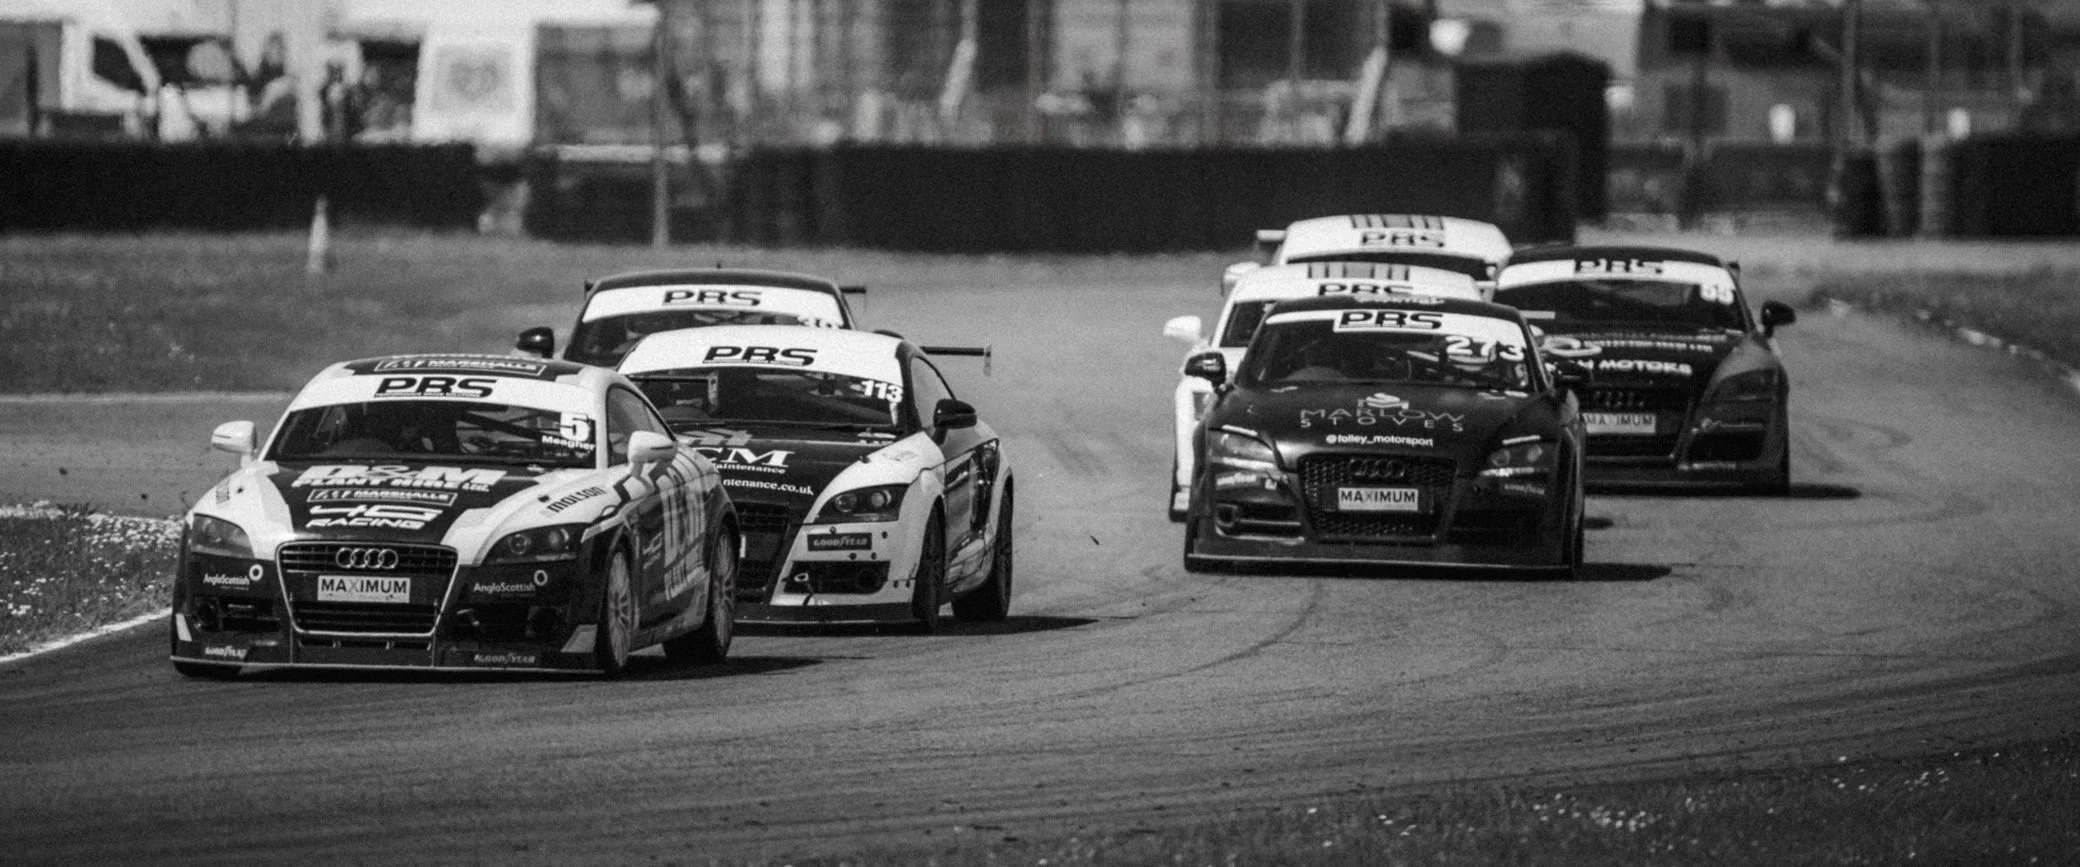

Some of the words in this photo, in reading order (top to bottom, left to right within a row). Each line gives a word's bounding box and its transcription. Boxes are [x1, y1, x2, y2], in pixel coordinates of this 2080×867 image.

[1362, 231, 1445, 249] PRS
[661, 289, 762, 307] PRS
[1319, 283, 1414, 298] PRS
[1339, 311, 1444, 330] PRS
[702, 345, 818, 367] PRS
[1445, 335, 1524, 361] 273
[1598, 359, 1692, 376] MOTORS
[373, 376, 498, 399] PRS
[860, 379, 903, 404] 113
[1300, 408, 1465, 422] MARLOW
[560, 411, 591, 442] 5
[1301, 417, 1464, 432] STOVES
[542, 435, 596, 451] Meagher
[291, 477, 389, 488] PLANT
[299, 464, 508, 486] D&M
[722, 478, 815, 496] ntenance.co.uk
[1340, 490, 1416, 505] MAXIMUM
[306, 517, 425, 530] RACING
[320, 579, 407, 594] MAXIMUM
[473, 582, 536, 594] AngloScottish
